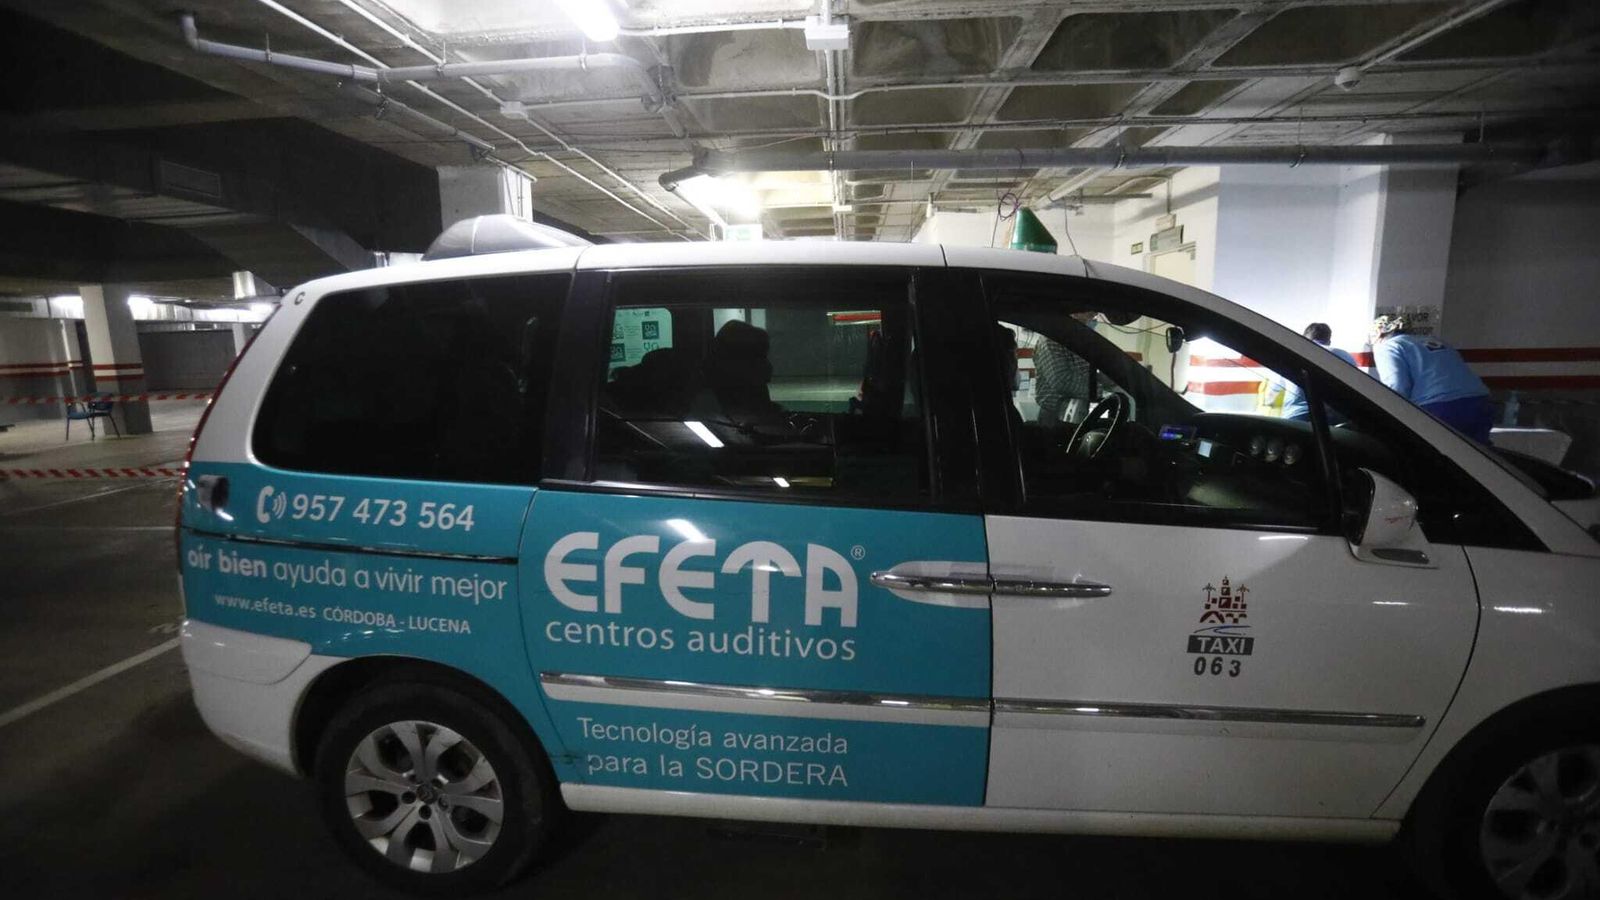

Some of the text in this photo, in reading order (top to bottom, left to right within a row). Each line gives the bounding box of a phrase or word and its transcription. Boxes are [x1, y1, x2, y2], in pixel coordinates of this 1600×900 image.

[292, 493, 475, 532] 957 473 564
[187, 546, 508, 605] oír bien ayuda a vivir mejor
[214, 594, 316, 618] www.efeta.es
[323, 606, 396, 628] CÓRDOBA
[408, 615, 471, 634] LUCENA
[545, 620, 857, 661] centros auditivos
[1196, 636, 1246, 654] TAXI
[1193, 656, 1242, 678] 063
[576, 716, 849, 755] Tecnología avanzada
[587, 752, 848, 788] para la SORDERA
